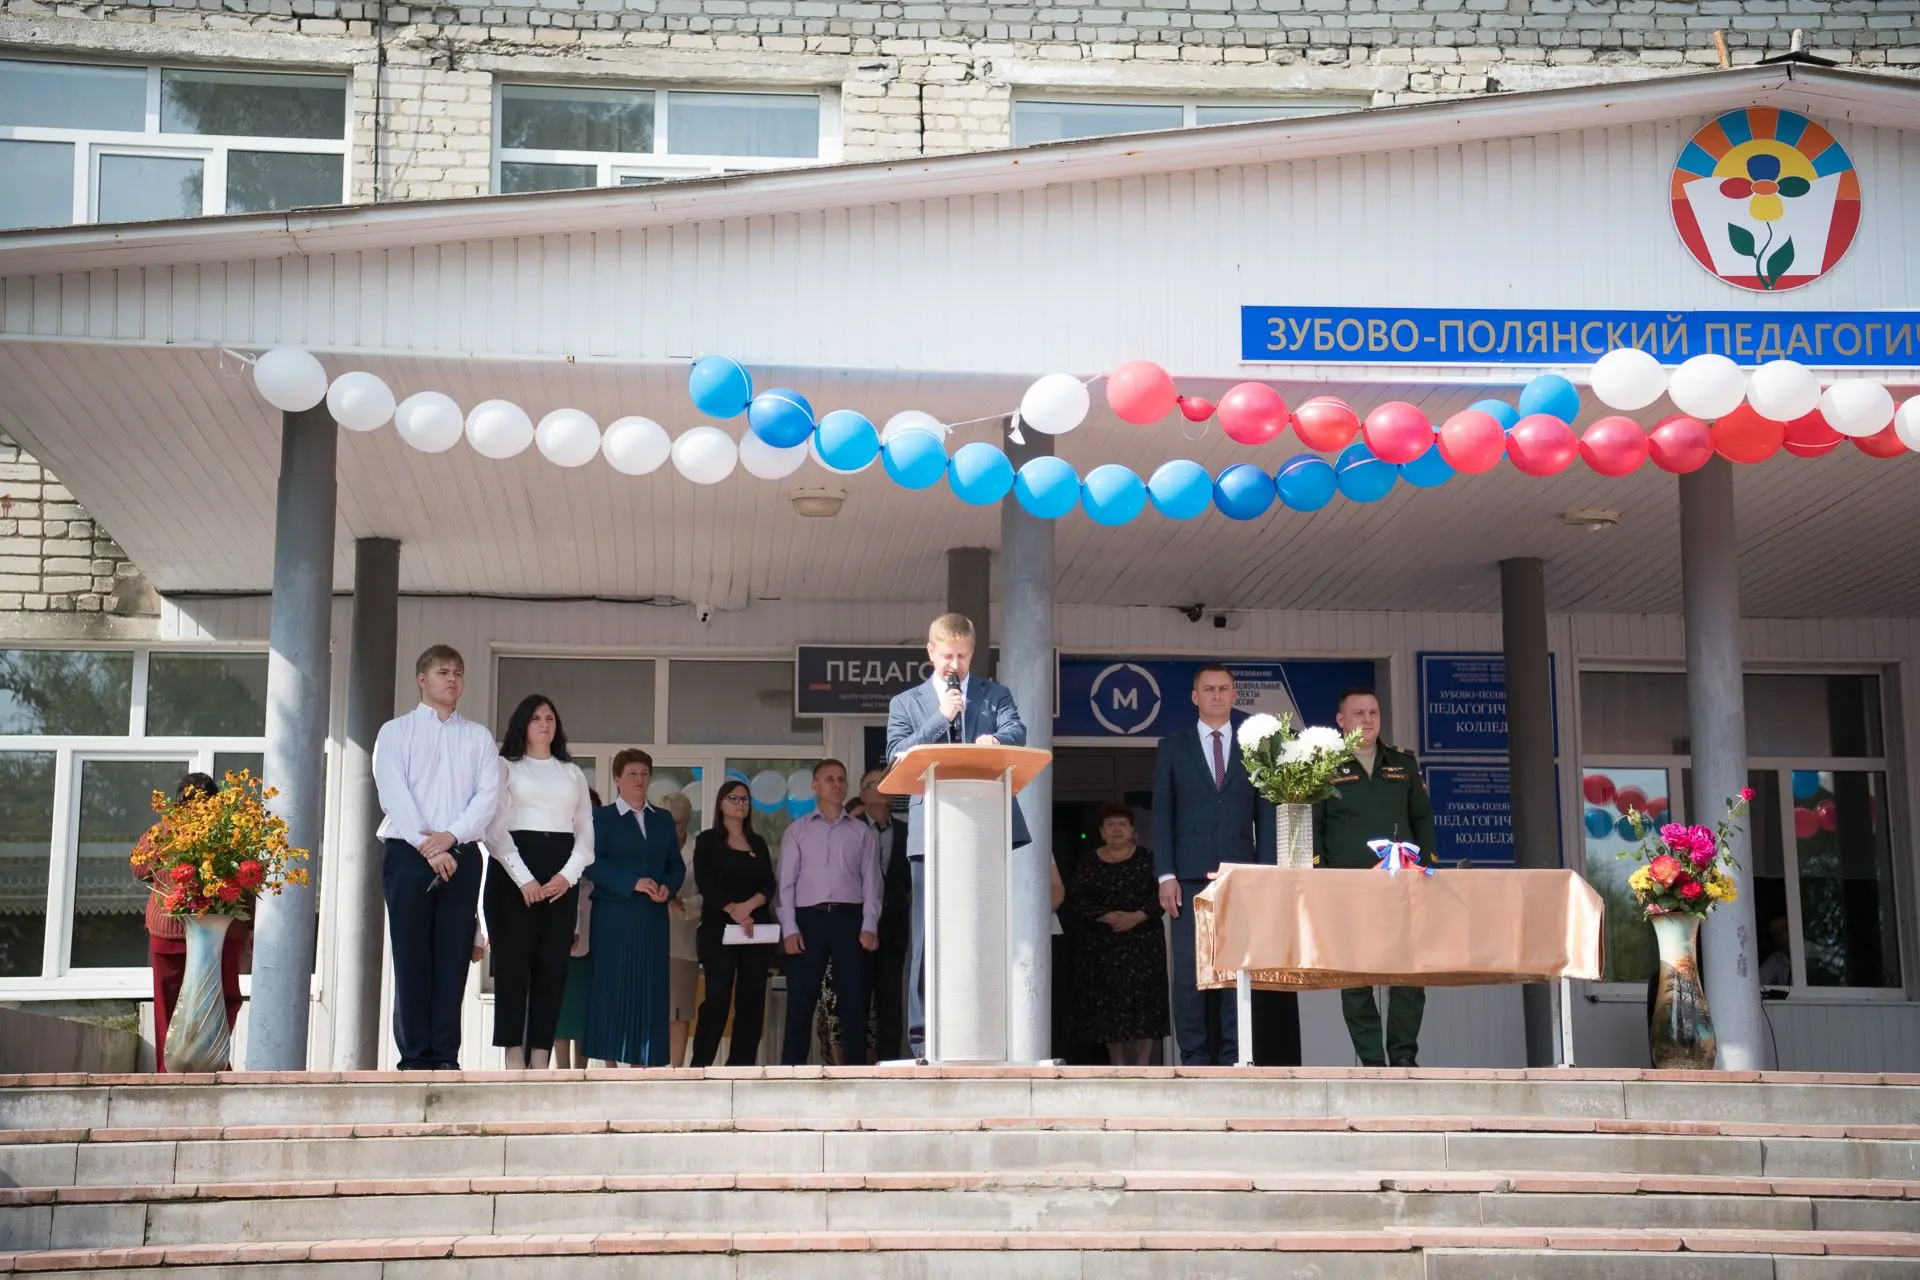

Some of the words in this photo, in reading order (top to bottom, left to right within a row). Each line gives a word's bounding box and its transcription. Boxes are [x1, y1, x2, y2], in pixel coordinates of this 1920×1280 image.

[1266, 314, 1688, 355] ЗУБОВО-ПОЛЯНСКИЙ
[1234, 682, 1281, 690] АЦИОНАЛЬНЫЕ
[1440, 690, 1507, 700] ЗУБОВО-ПОЛЯ
